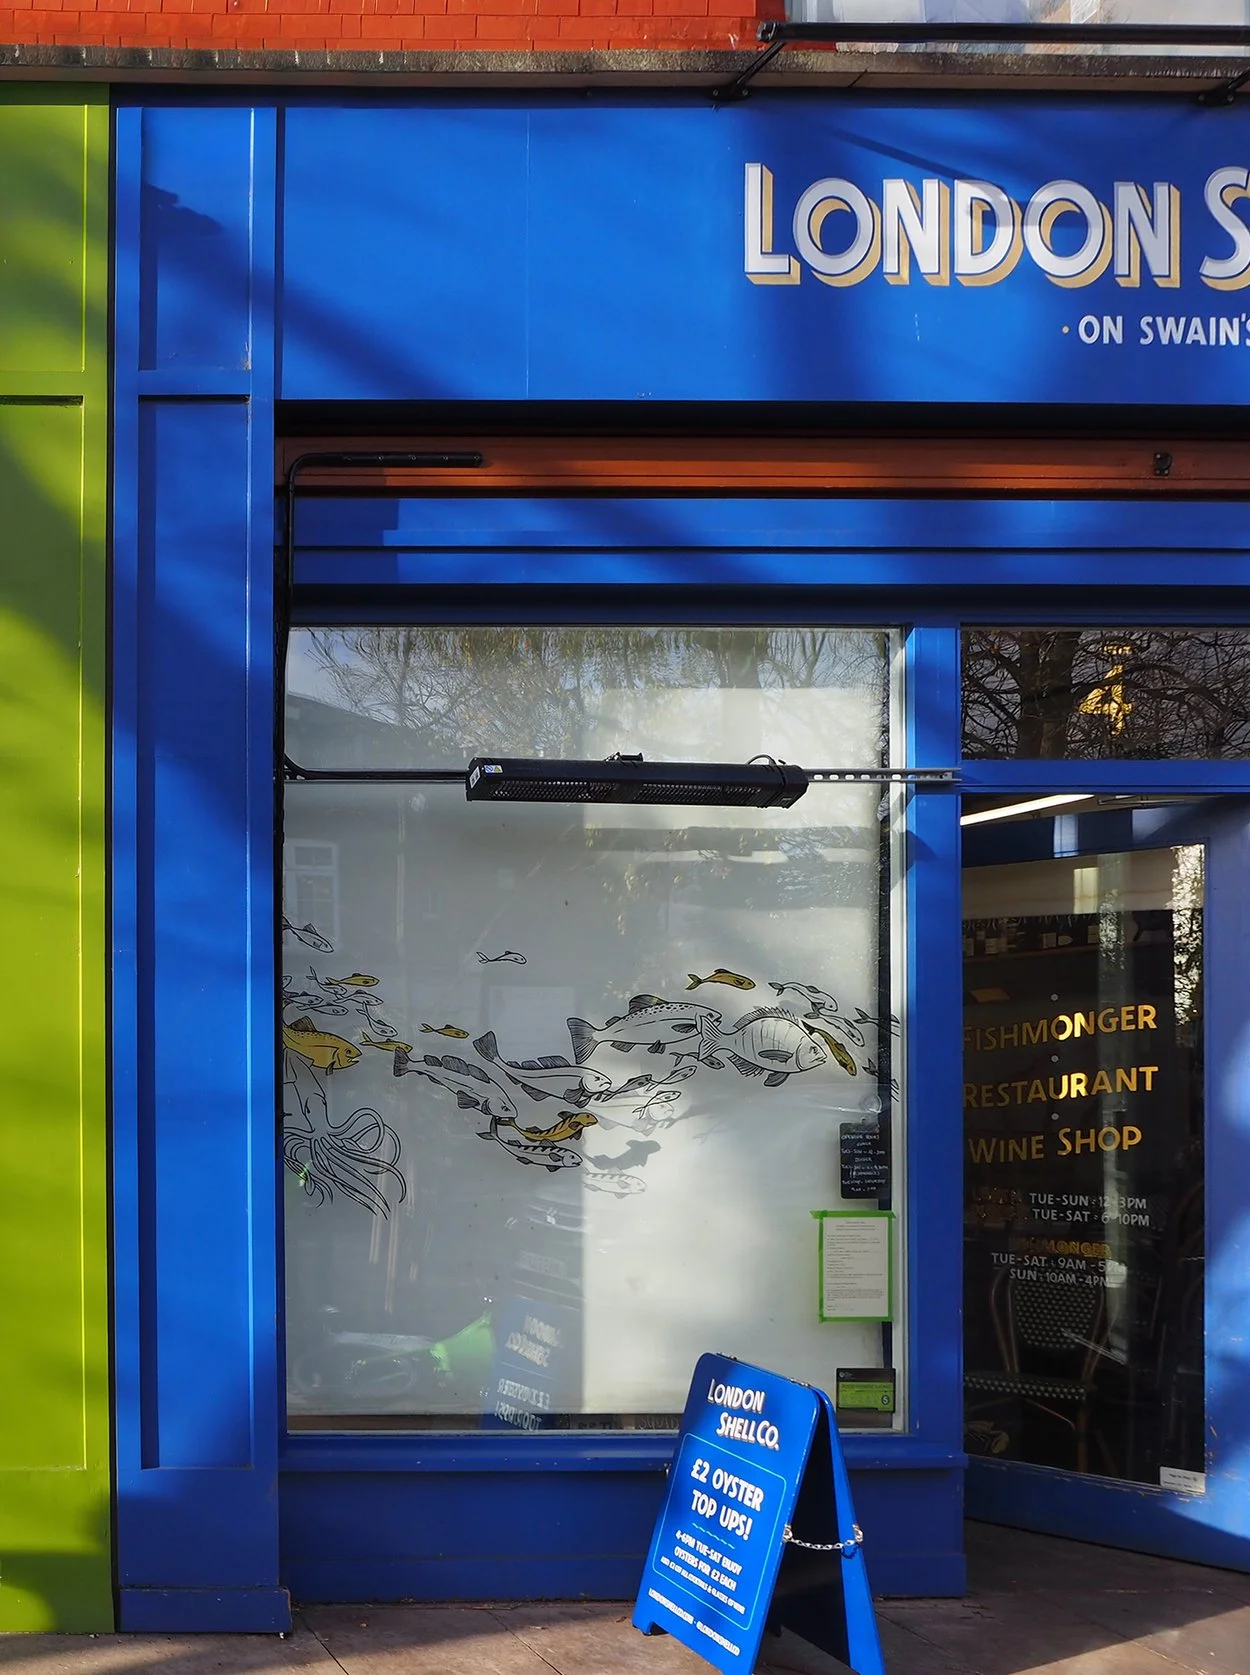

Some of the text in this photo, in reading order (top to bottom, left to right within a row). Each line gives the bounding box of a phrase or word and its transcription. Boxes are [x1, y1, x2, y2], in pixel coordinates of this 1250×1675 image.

[744, 162, 1181, 289] LONDON
[1077, 315, 1124, 345] ON
[963, 1066, 1159, 1108] RESTAURANT
[968, 1126, 1143, 1164] WINE SHOP
[707, 1378, 765, 1413] LONDON
[716, 1411, 758, 1444] SHELL
[690, 1458, 765, 1512] £2 OYSTER
[692, 1489, 754, 1541] TOP UPS!
